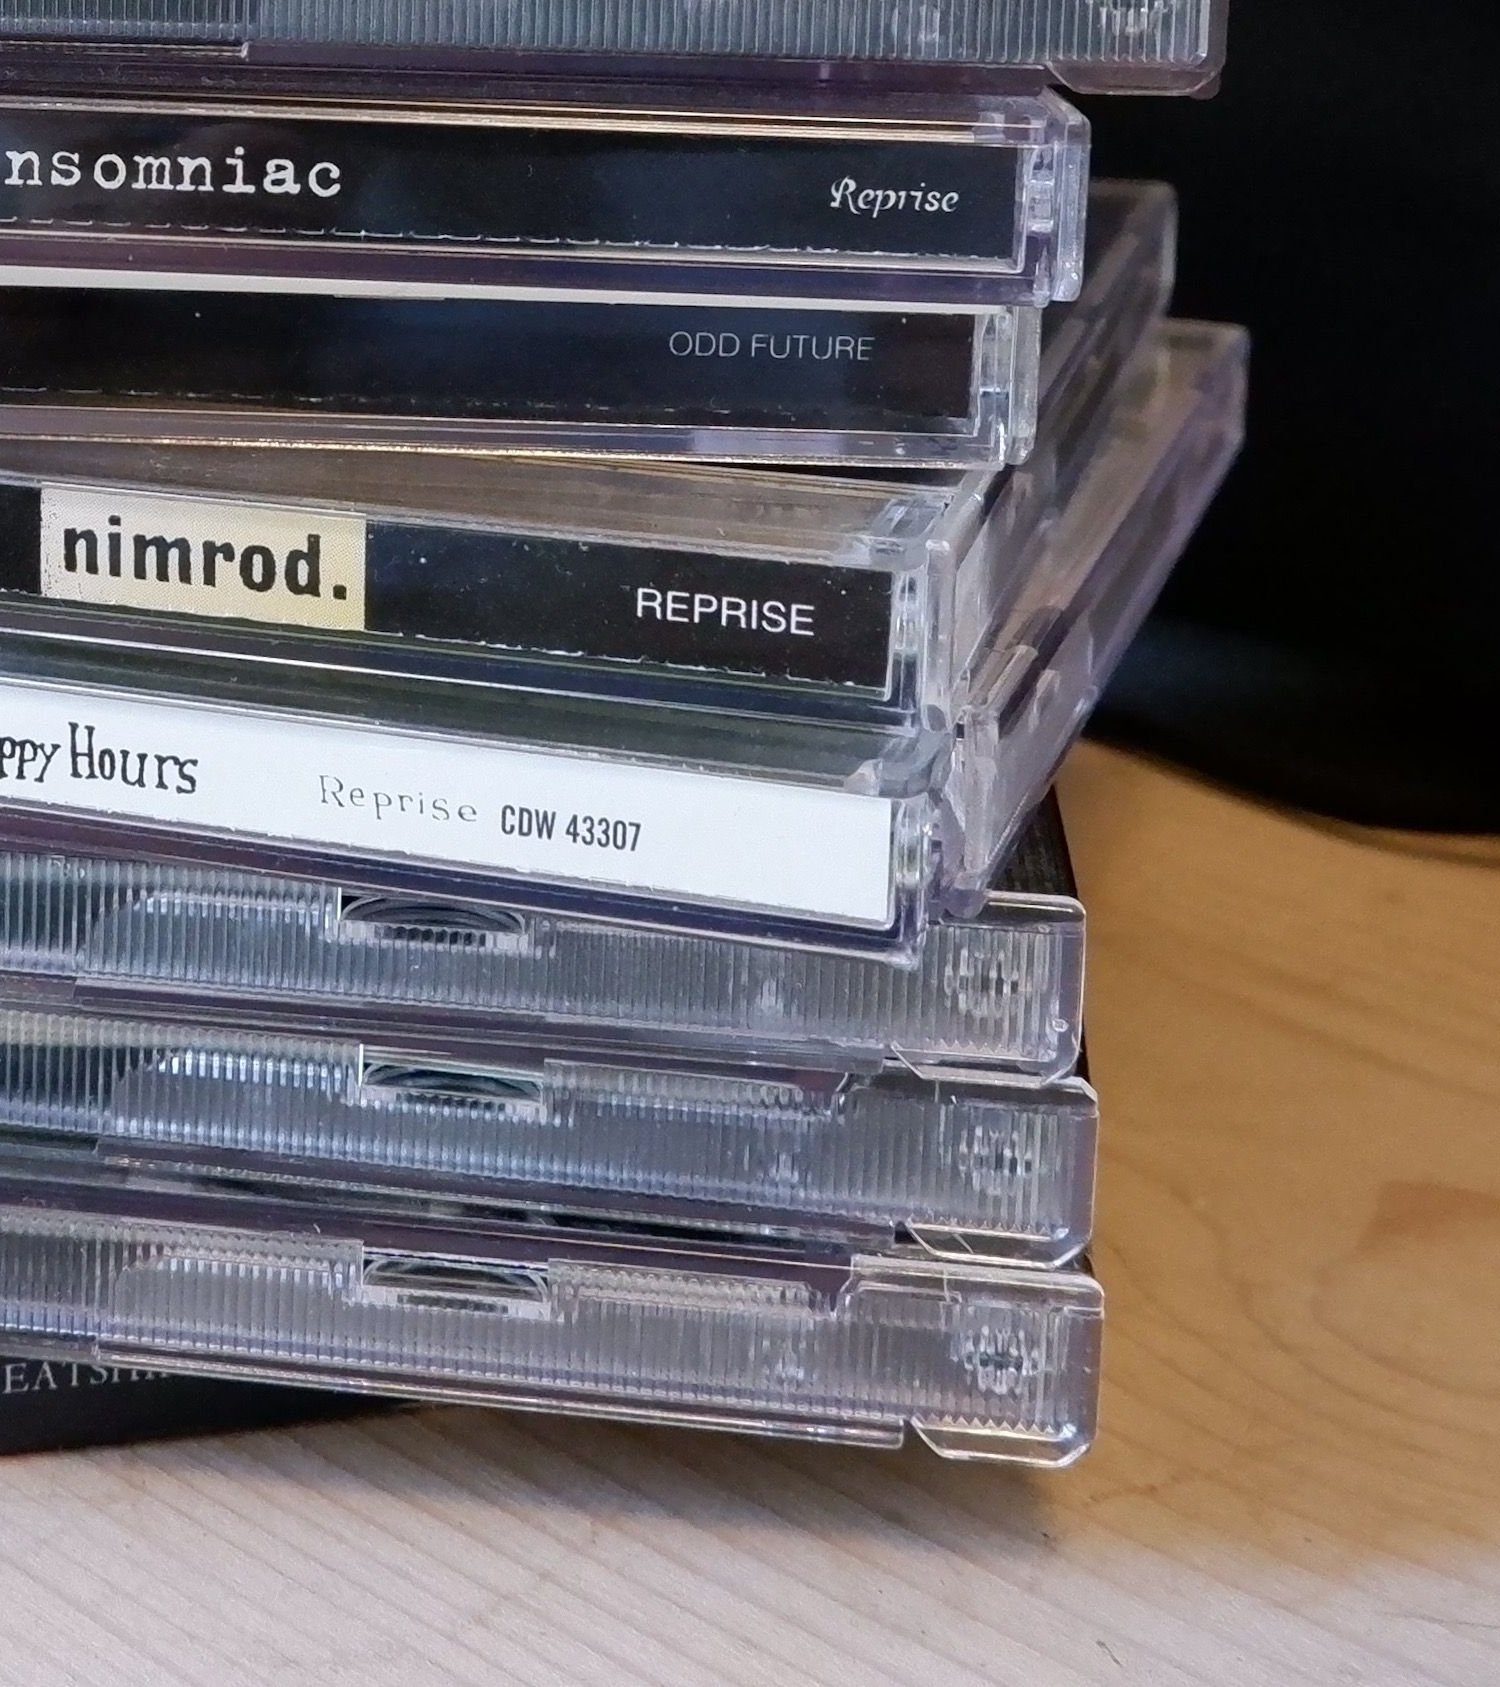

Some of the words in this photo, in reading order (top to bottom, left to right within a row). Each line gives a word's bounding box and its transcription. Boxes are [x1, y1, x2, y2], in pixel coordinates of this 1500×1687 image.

[830, 176, 960, 218] Reprise
[669, 331, 741, 357] ODD
[751, 333, 876, 361] FUTURE
[63, 515, 348, 601] nimrod.
[635, 587, 816, 637] REPRISE
[68, 722, 199, 793] Hours
[318, 774, 478, 822] Reprise
[500, 804, 557, 840] CDW
[565, 814, 642, 852] 43307
